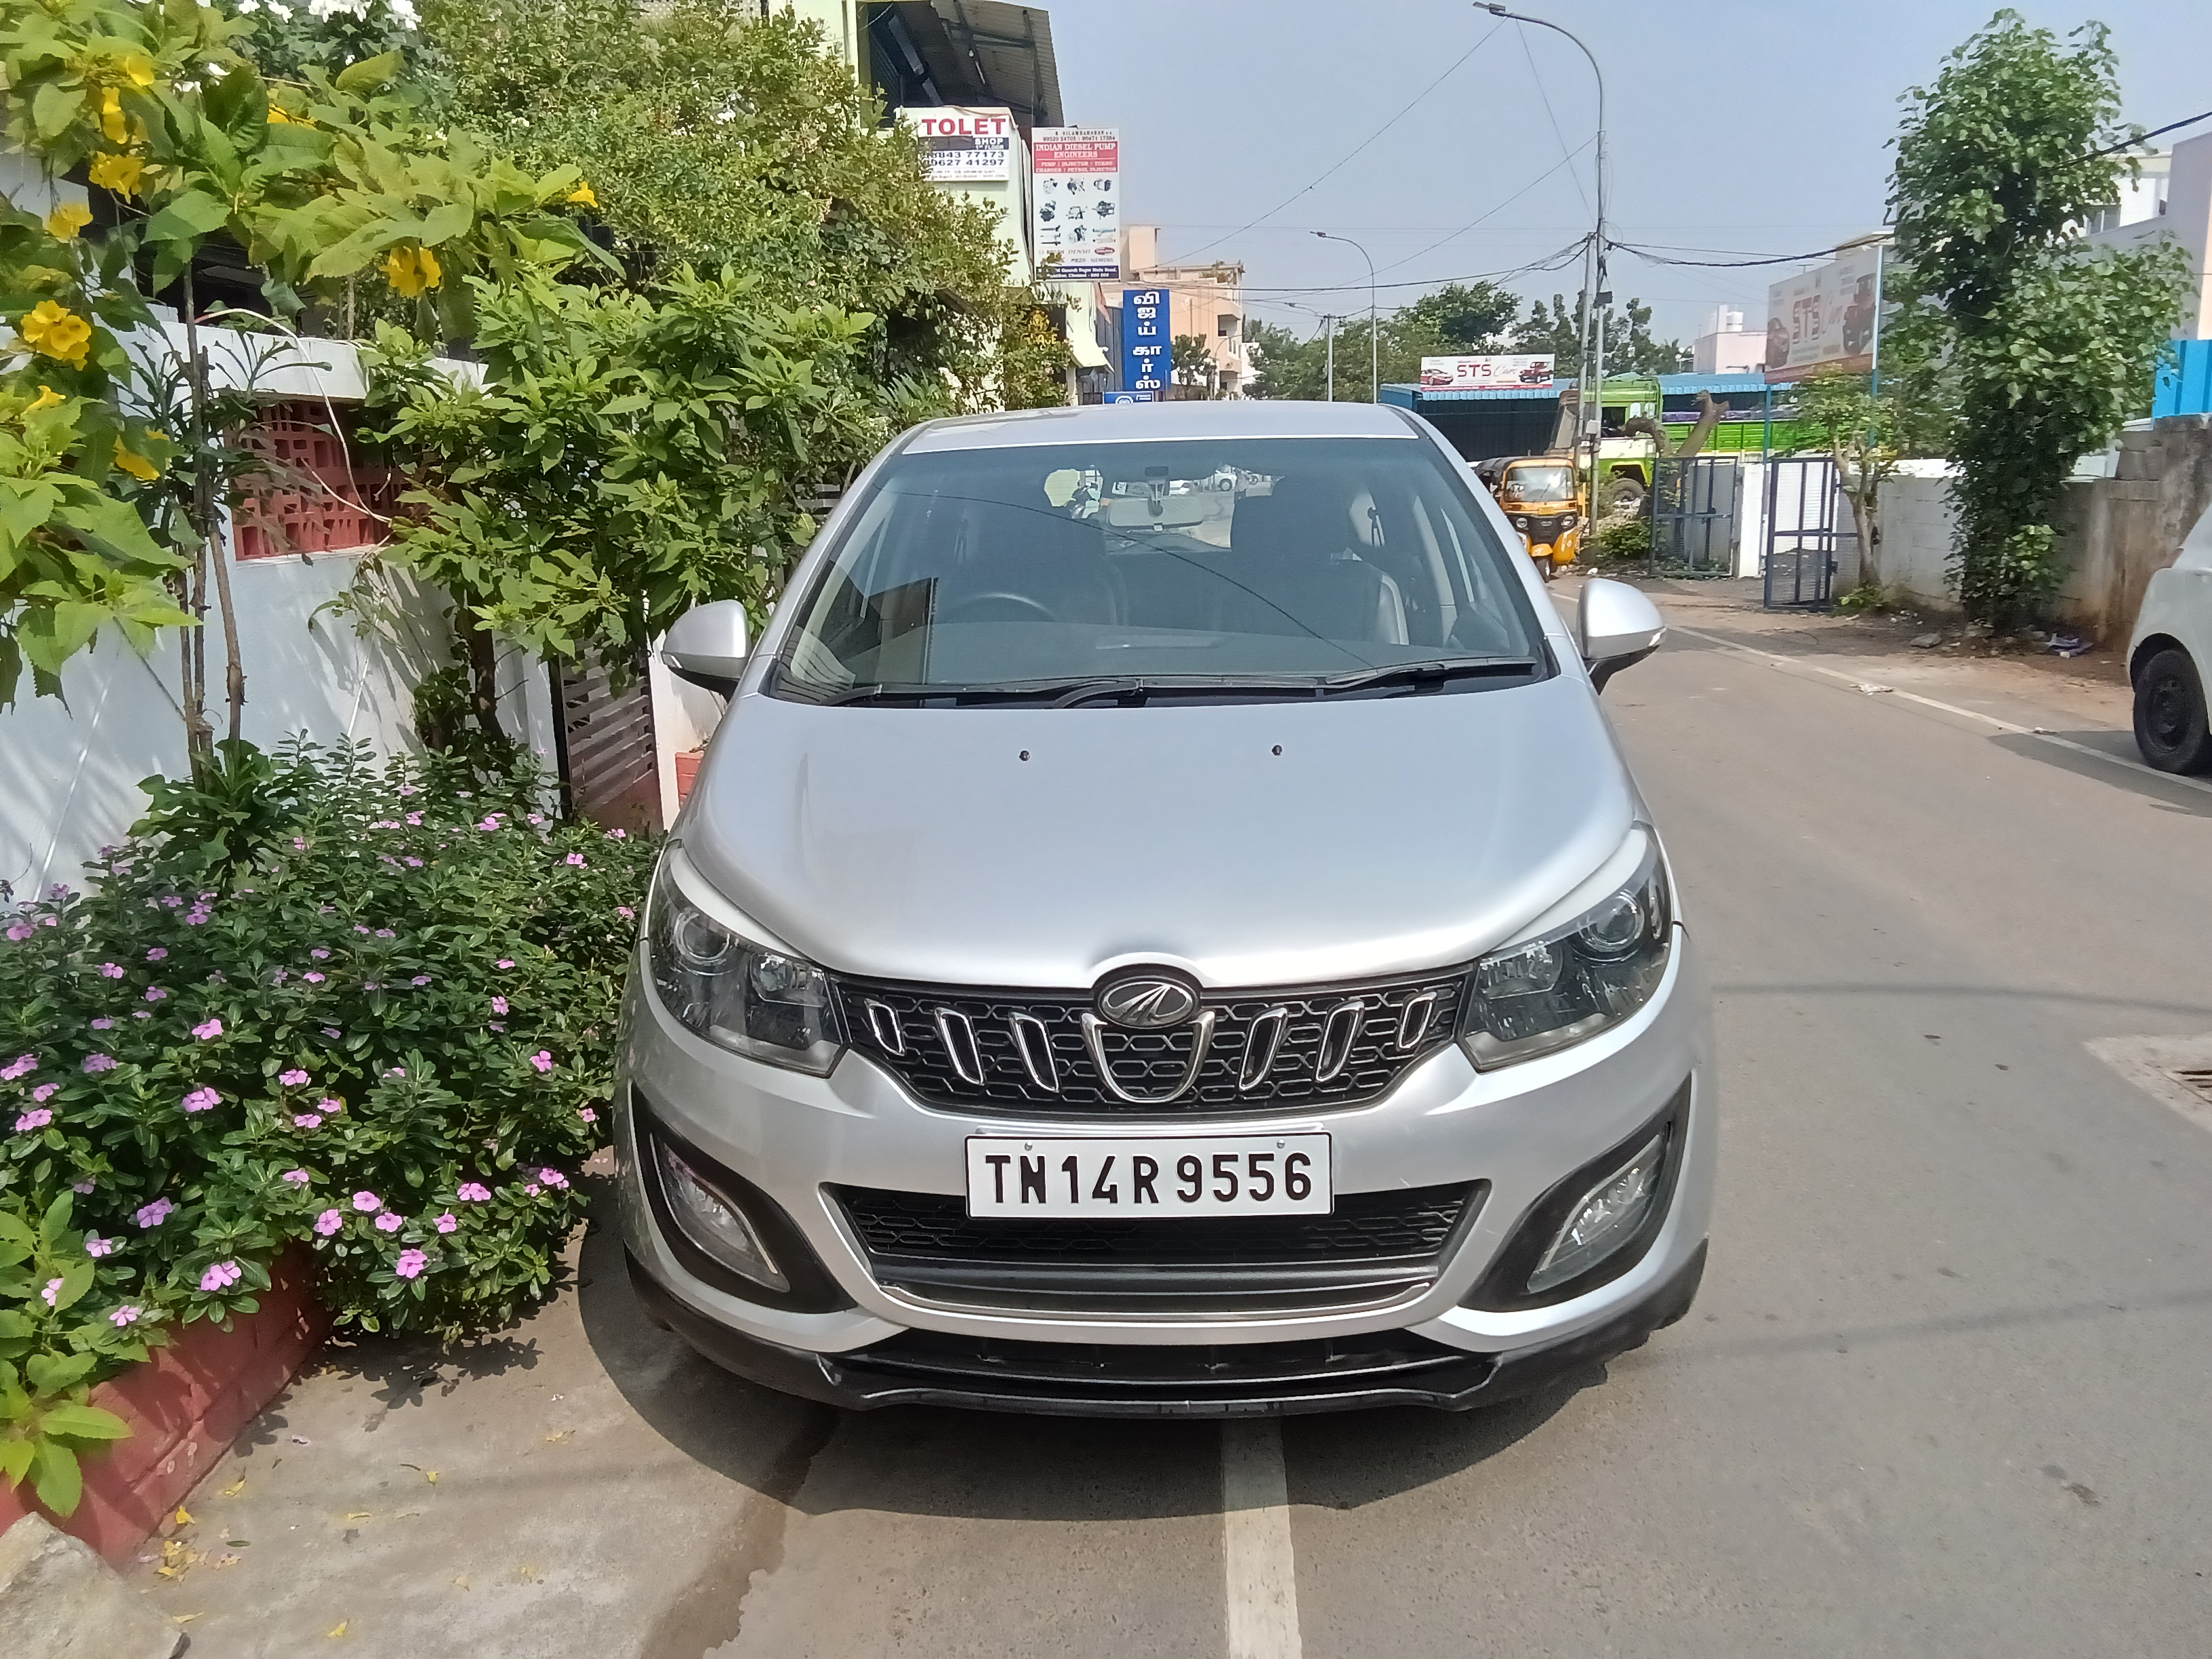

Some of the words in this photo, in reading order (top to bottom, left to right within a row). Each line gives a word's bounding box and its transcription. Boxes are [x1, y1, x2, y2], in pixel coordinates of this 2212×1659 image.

[922, 118, 1006, 135] TOLET
[1036, 143, 1063, 151] INDIAN
[1792, 294, 1820, 344] STS
[1457, 364, 1492, 377] STS
